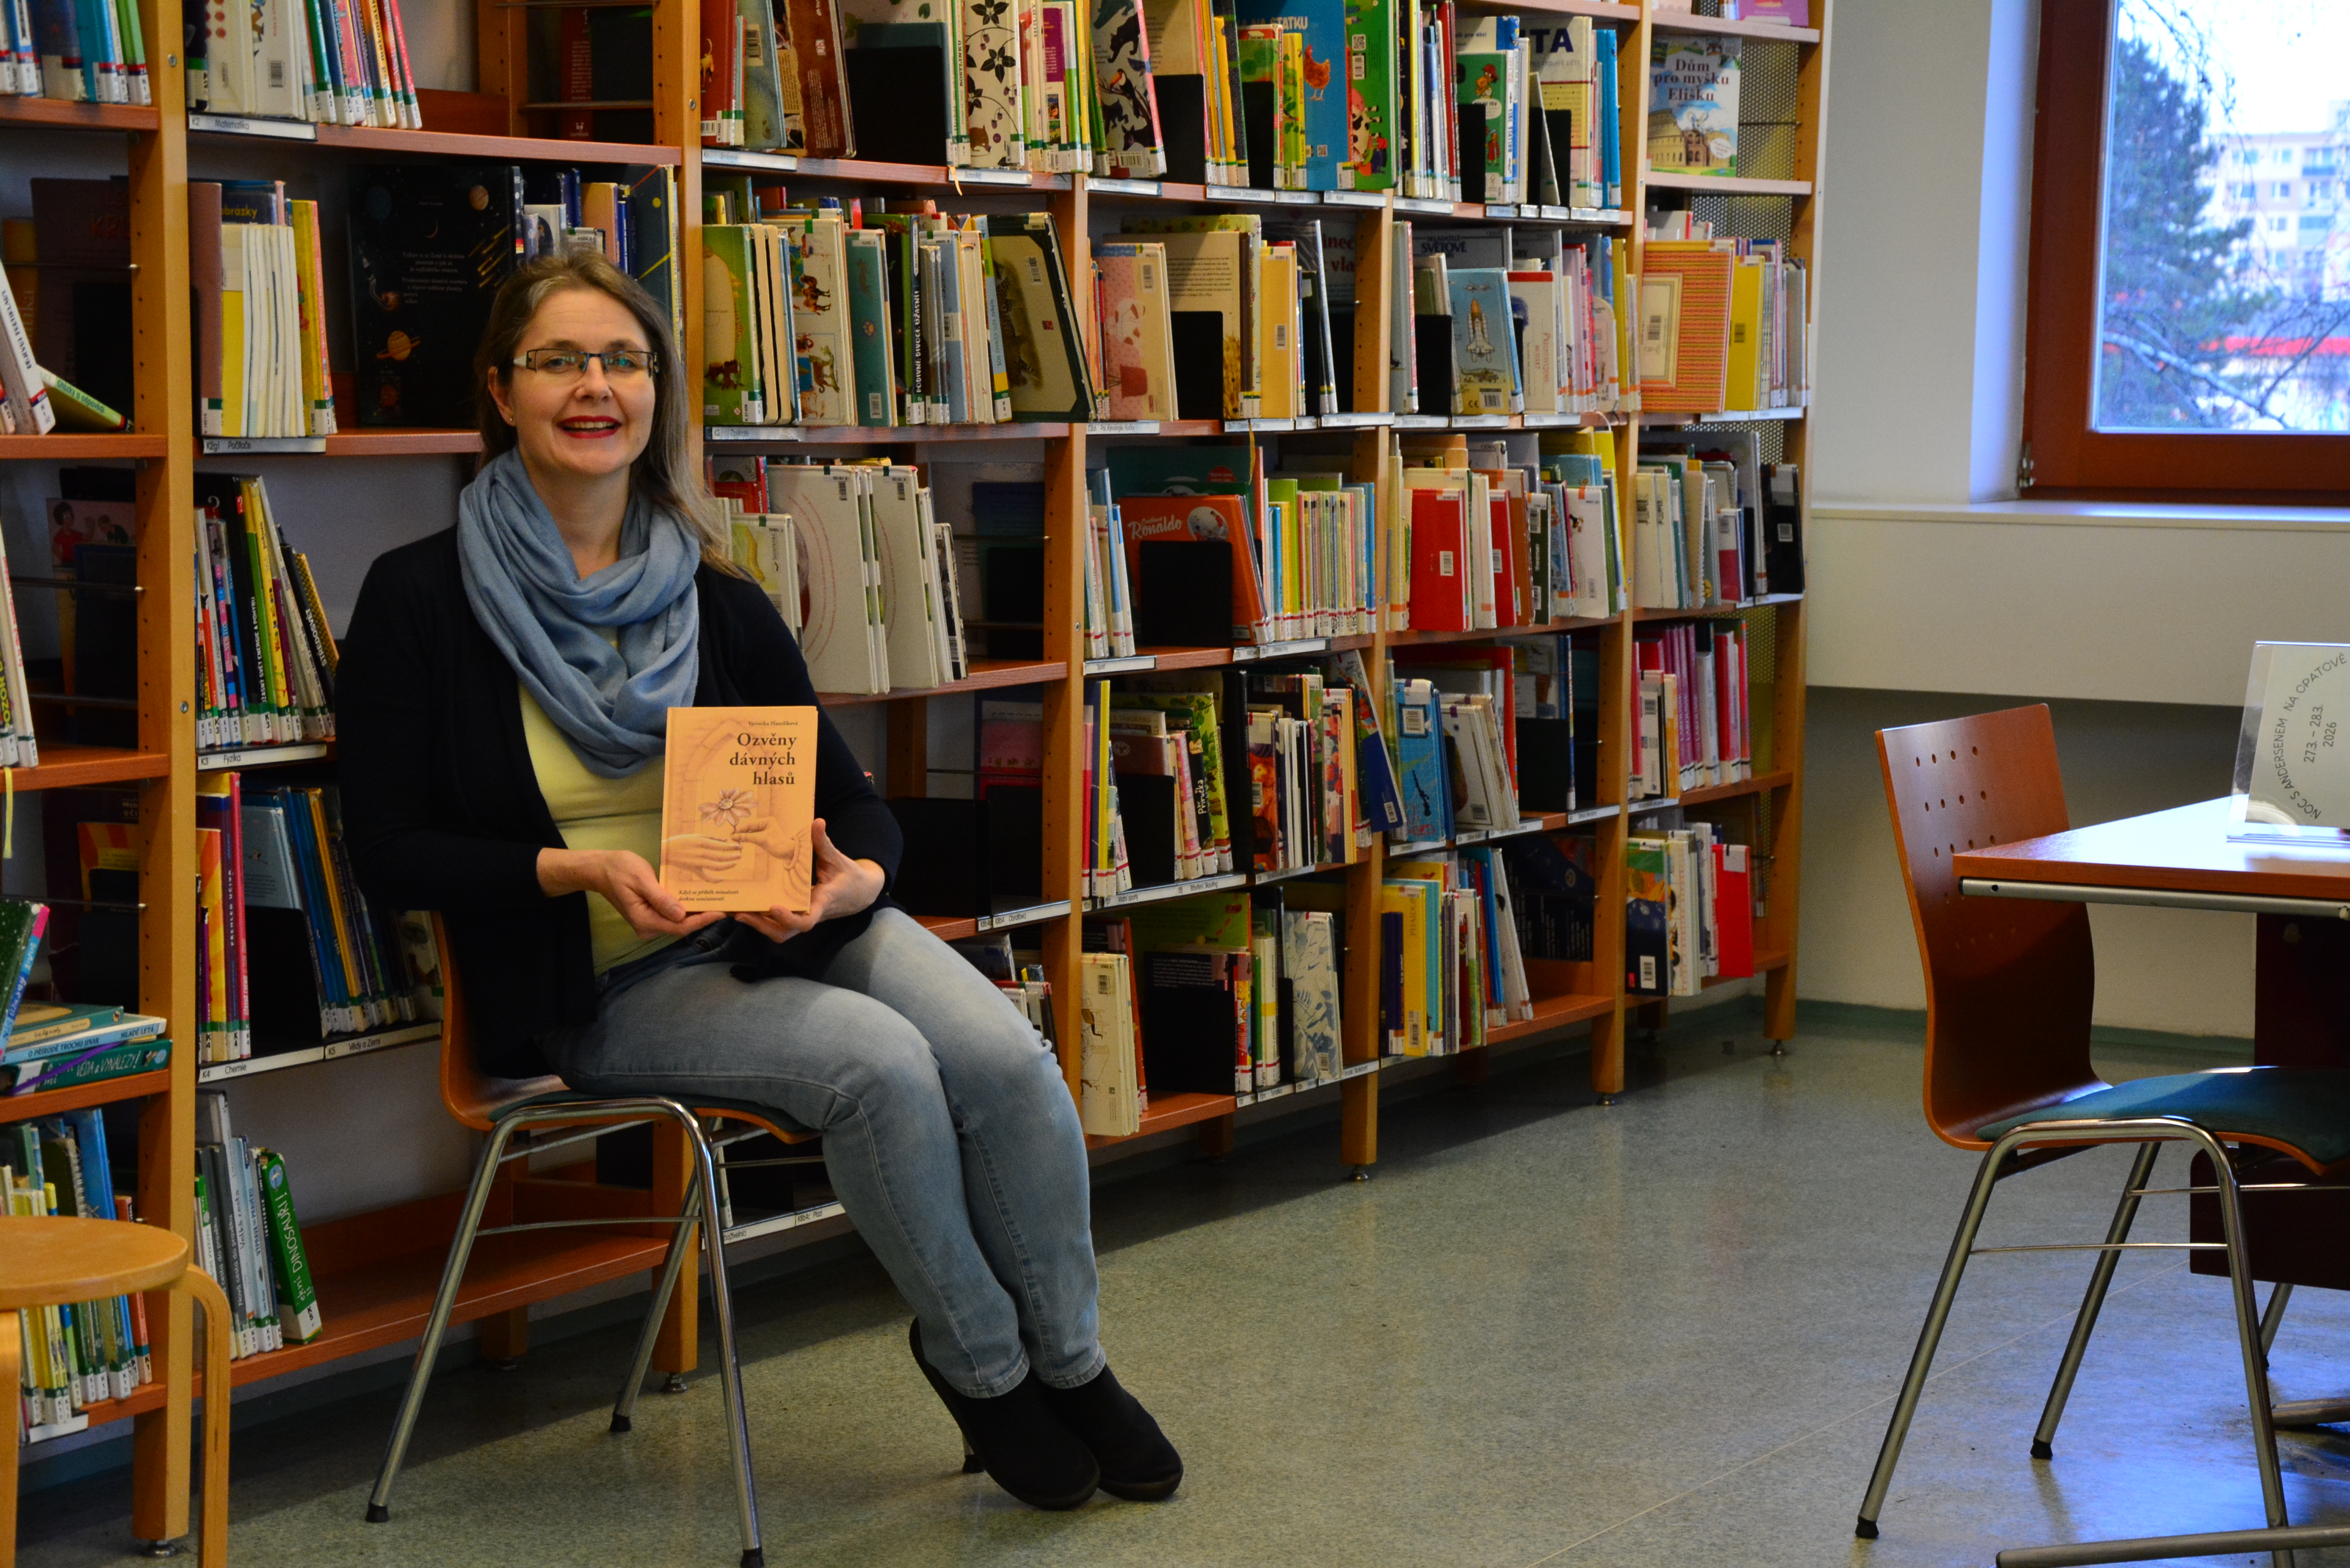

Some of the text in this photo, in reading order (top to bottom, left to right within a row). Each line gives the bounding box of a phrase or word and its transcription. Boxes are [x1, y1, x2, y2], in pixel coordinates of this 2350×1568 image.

[1676, 59, 1710, 71] Dům
[1654, 73, 1729, 87] pro myšku
[1668, 86, 1714, 101] Elišku
[215, 119, 249, 130] Matematika
[1128, 515, 1183, 540] Ronaldo
[2283, 696, 2299, 711] NA
[738, 733, 797, 750] Ozvěny
[2323, 722, 2336, 747] 2026
[224, 755, 241, 764] Fyzika
[730, 752, 795, 769] dávných
[2274, 718, 2295, 790] ANDERSENEM
[753, 771, 795, 785] hlasů
[1194, 779, 1206, 814] Příručka
[2297, 799, 2321, 819] NOC
[121, 1030, 139, 1039] MLADÉ
[367, 1038, 381, 1047] Zemi
[33, 1045, 58, 1056] PŘÍRODĚ
[61, 1041, 84, 1051] TROCHU
[84, 1037, 99, 1046] JINAK
[76, 1062, 94, 1077] VĚDA
[99, 1051, 141, 1075] VYNÁLEZY!
[225, 1064, 246, 1074] Chemie
[813, 1210, 823, 1219] Plazi
[228, 1215, 237, 1245] pravěku
[275, 1192, 303, 1274] DINOSAUŘI!
